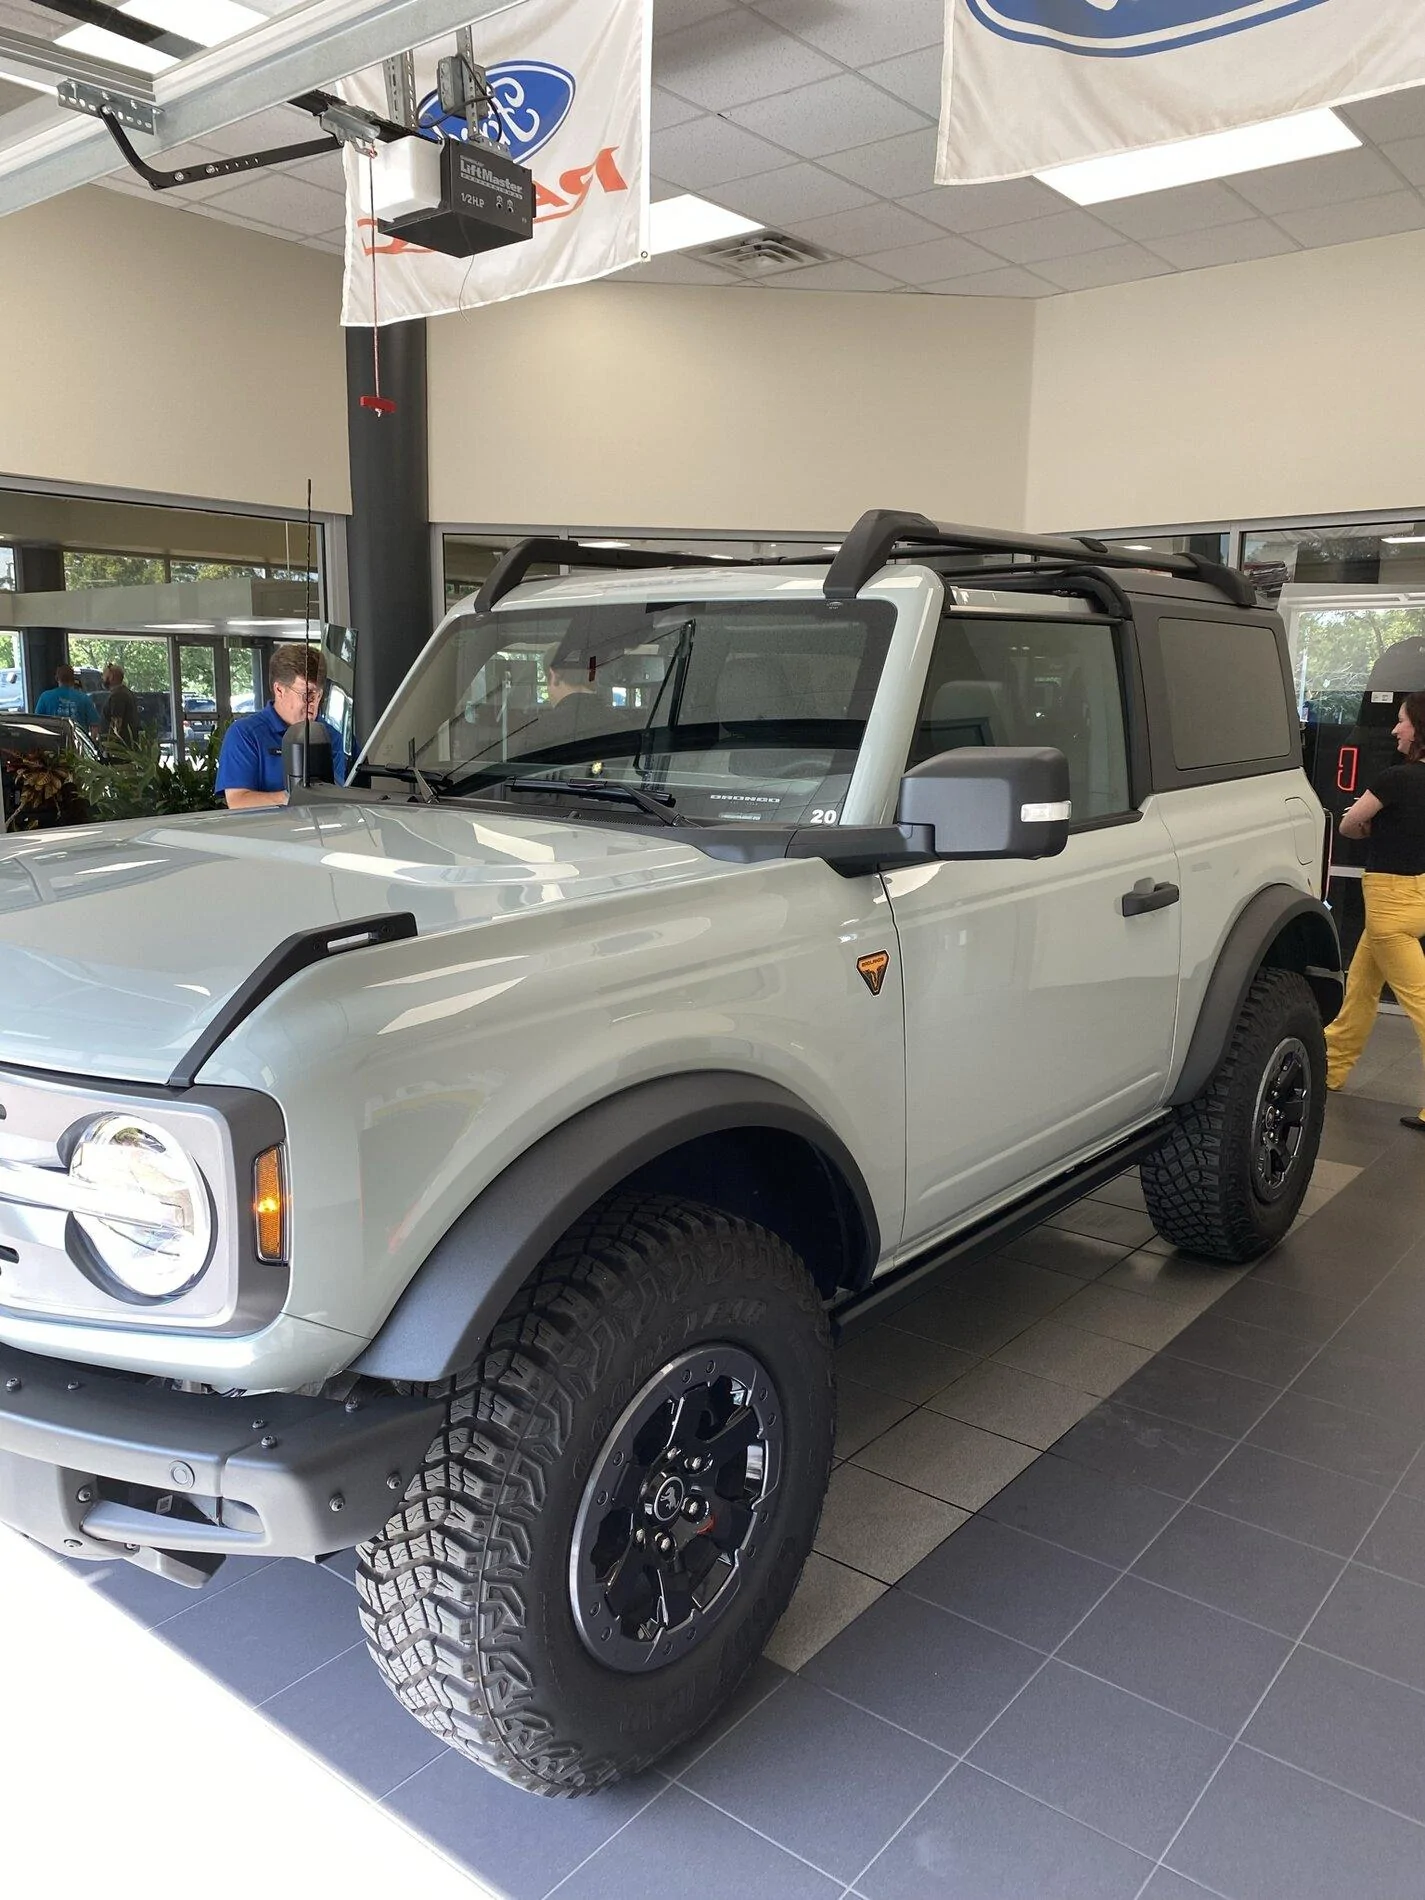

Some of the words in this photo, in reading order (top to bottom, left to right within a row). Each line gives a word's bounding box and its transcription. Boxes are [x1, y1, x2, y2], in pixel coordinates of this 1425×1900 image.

[460, 159, 523, 193] LiftMaster
[710, 794, 780, 803] BRONCO
[810, 809, 837, 824] 20
